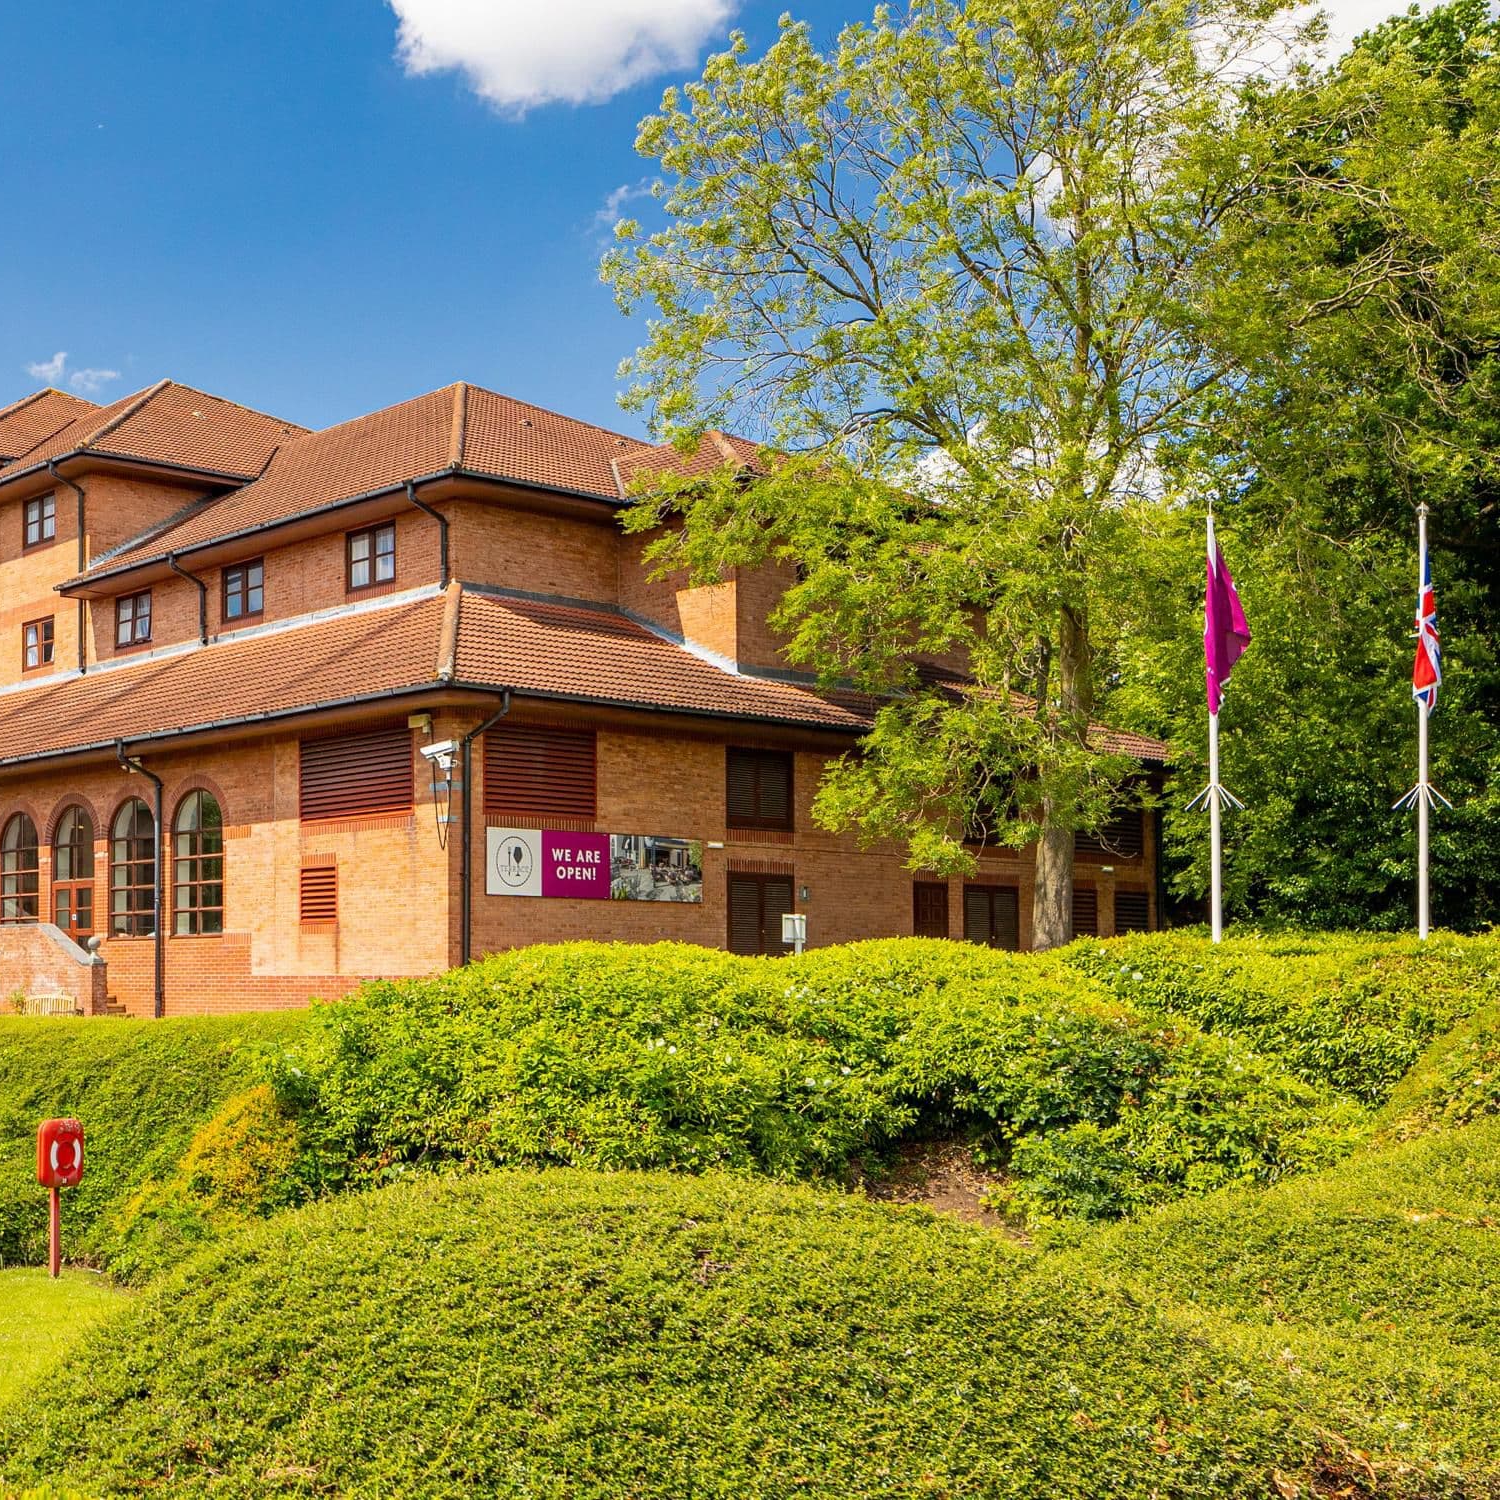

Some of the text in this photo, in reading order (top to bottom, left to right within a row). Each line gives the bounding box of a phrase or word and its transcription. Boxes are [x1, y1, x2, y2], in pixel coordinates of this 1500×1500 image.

[551, 848, 601, 863] WE ARE
[556, 866, 596, 880] OPEN!
